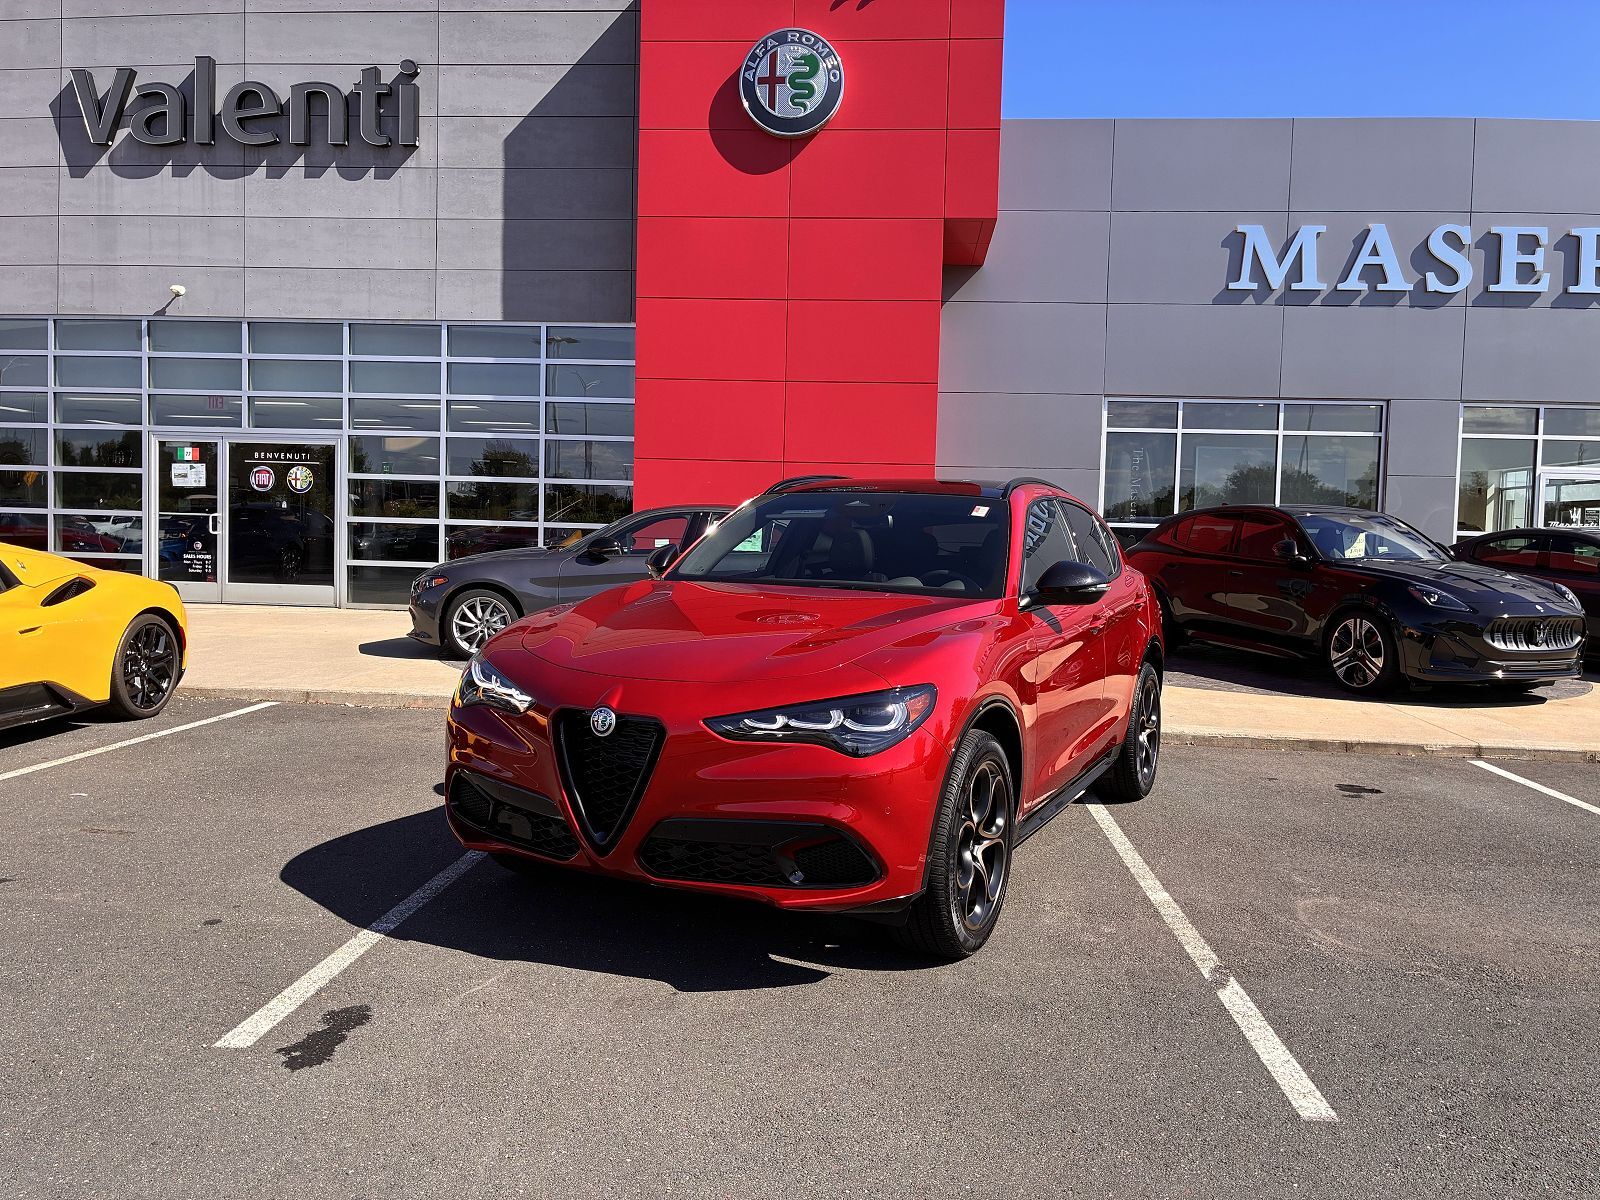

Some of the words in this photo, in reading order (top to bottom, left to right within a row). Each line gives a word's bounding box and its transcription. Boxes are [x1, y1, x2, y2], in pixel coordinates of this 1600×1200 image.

[744, 38, 778, 82] ALFA
[787, 32, 840, 82] ROMEO
[69, 55, 420, 147] Valenti
[254, 451, 310, 460] BENVENUTI
[1132, 447, 1144, 471] The
[255, 473, 270, 485] FIAT
